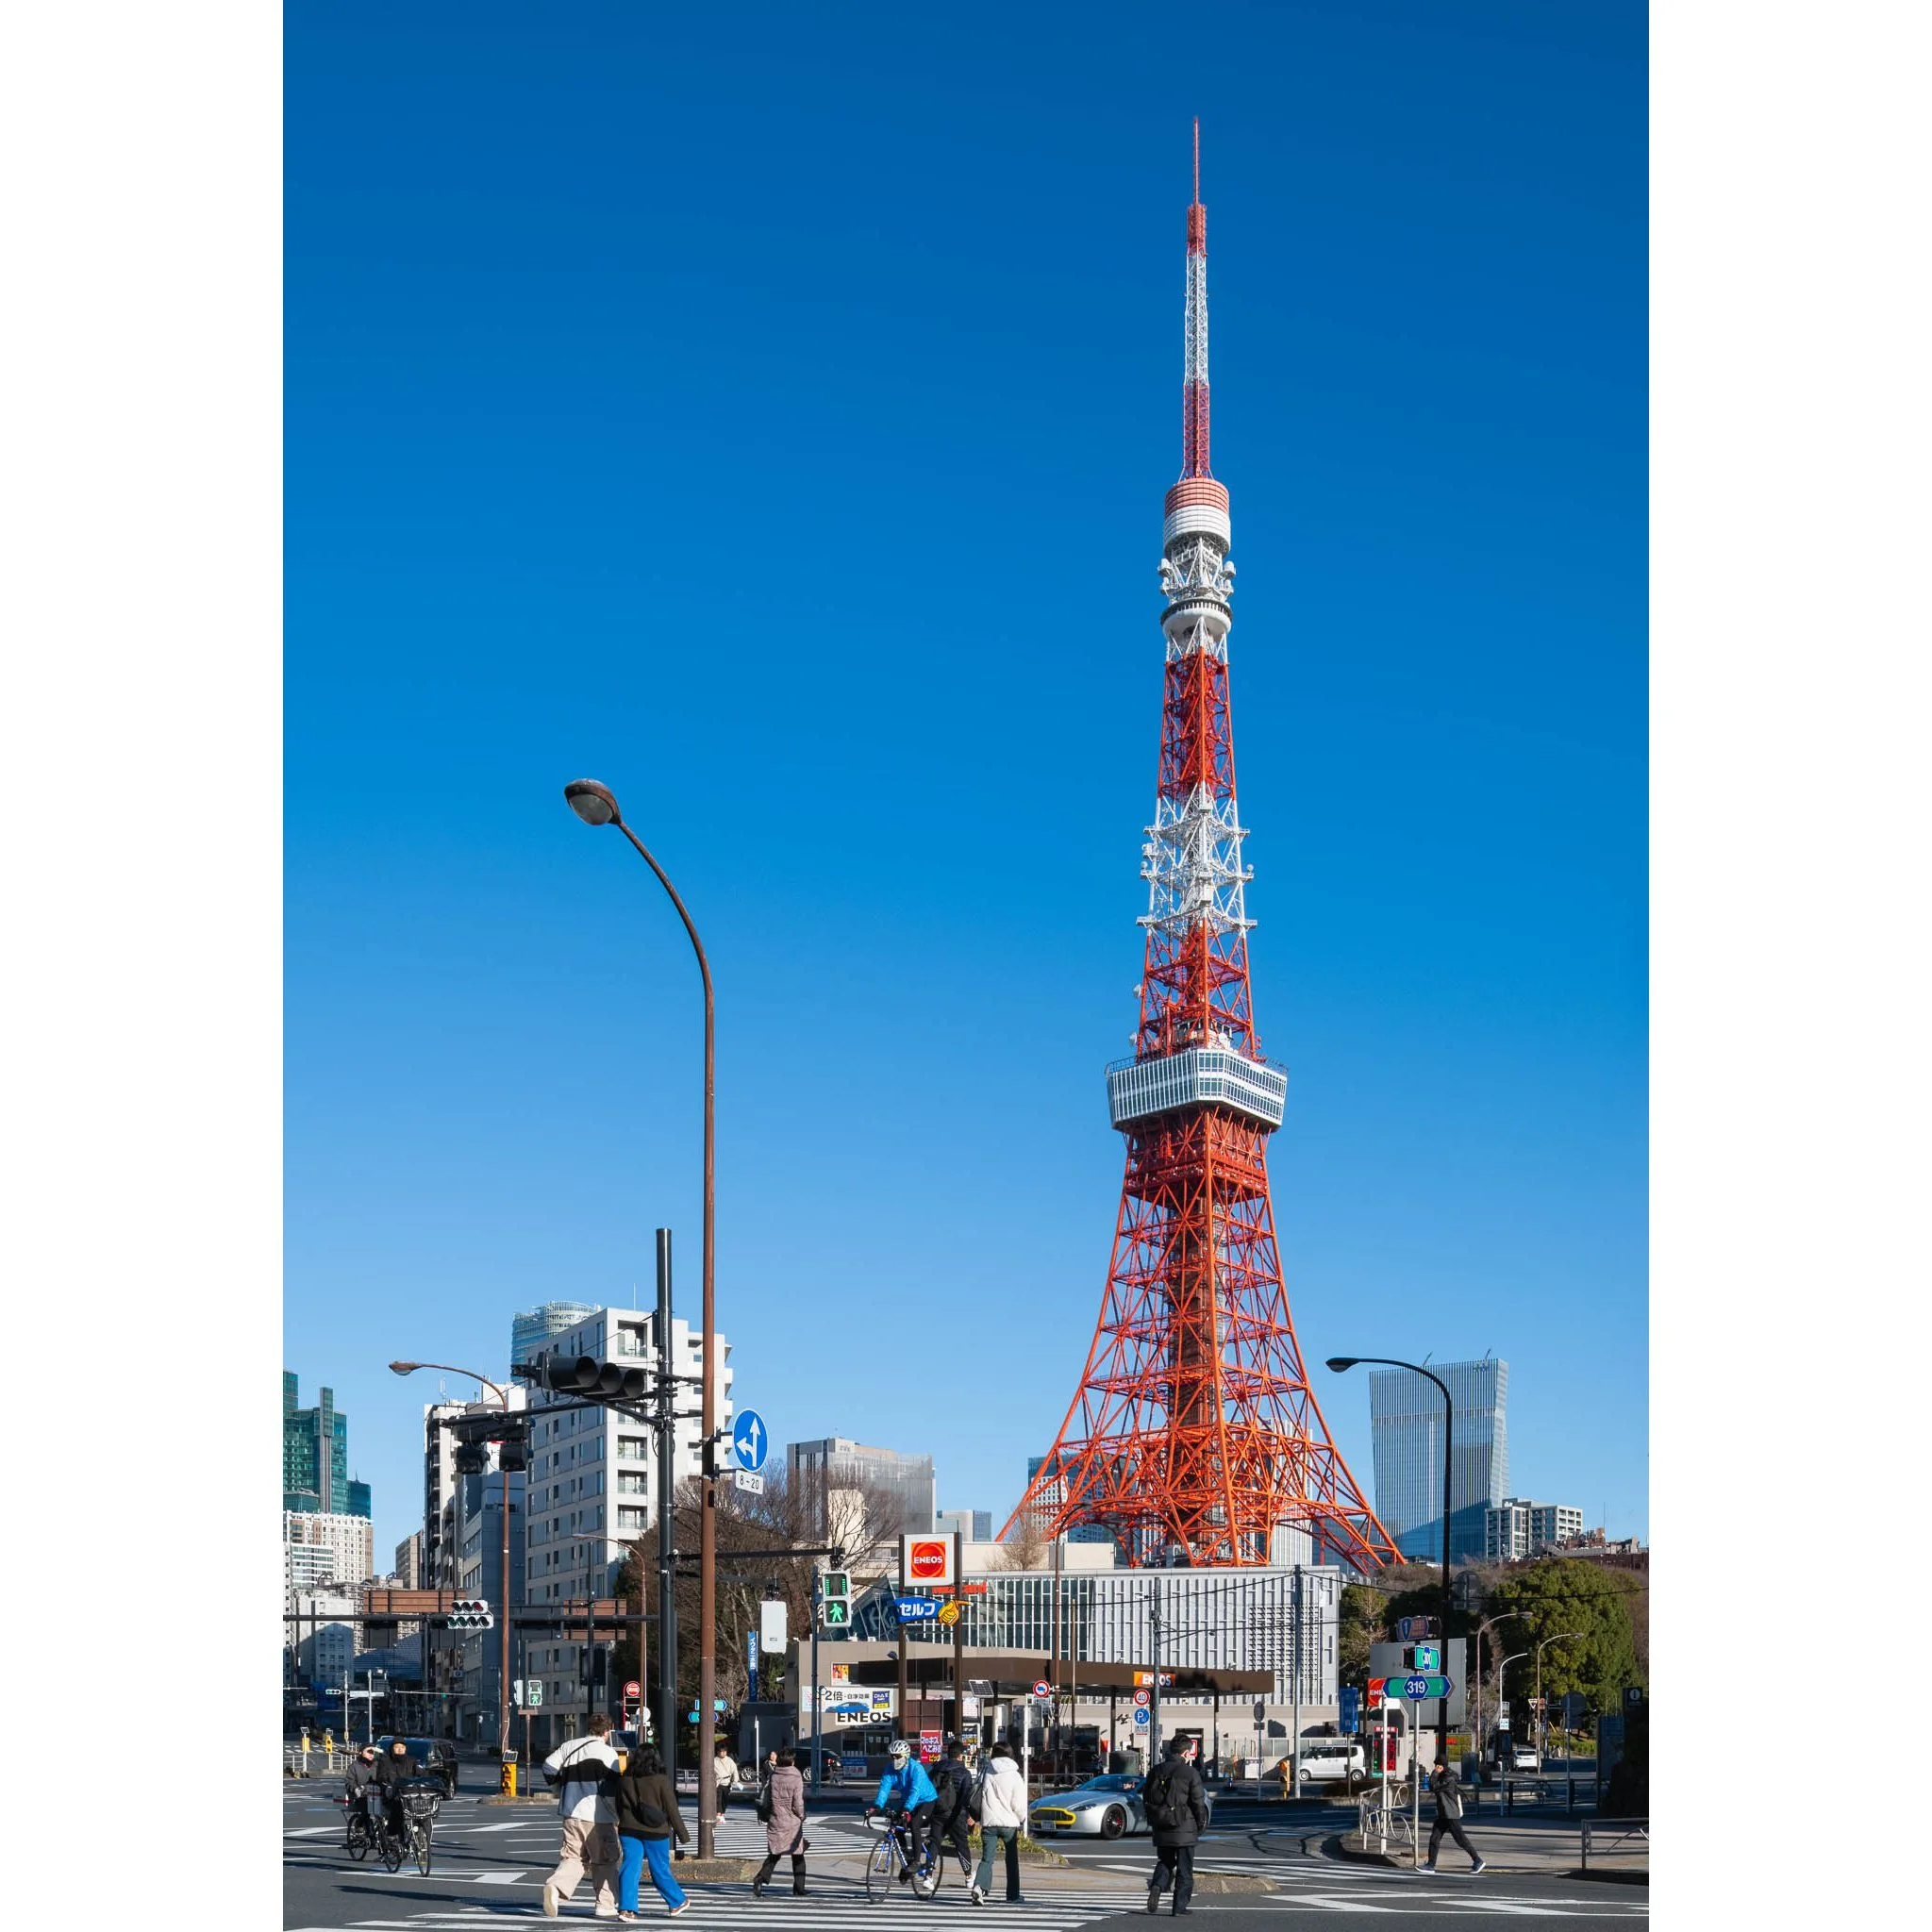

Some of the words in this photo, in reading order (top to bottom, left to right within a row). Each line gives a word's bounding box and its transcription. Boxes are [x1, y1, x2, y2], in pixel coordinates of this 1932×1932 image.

[913, 1556, 943, 1564] ENEOS
[899, 1603, 936, 1616] セルフ
[1142, 1674, 1171, 1687] ENOS
[1407, 1680, 1426, 1694] 319
[837, 1711, 891, 1724] ENEOS
